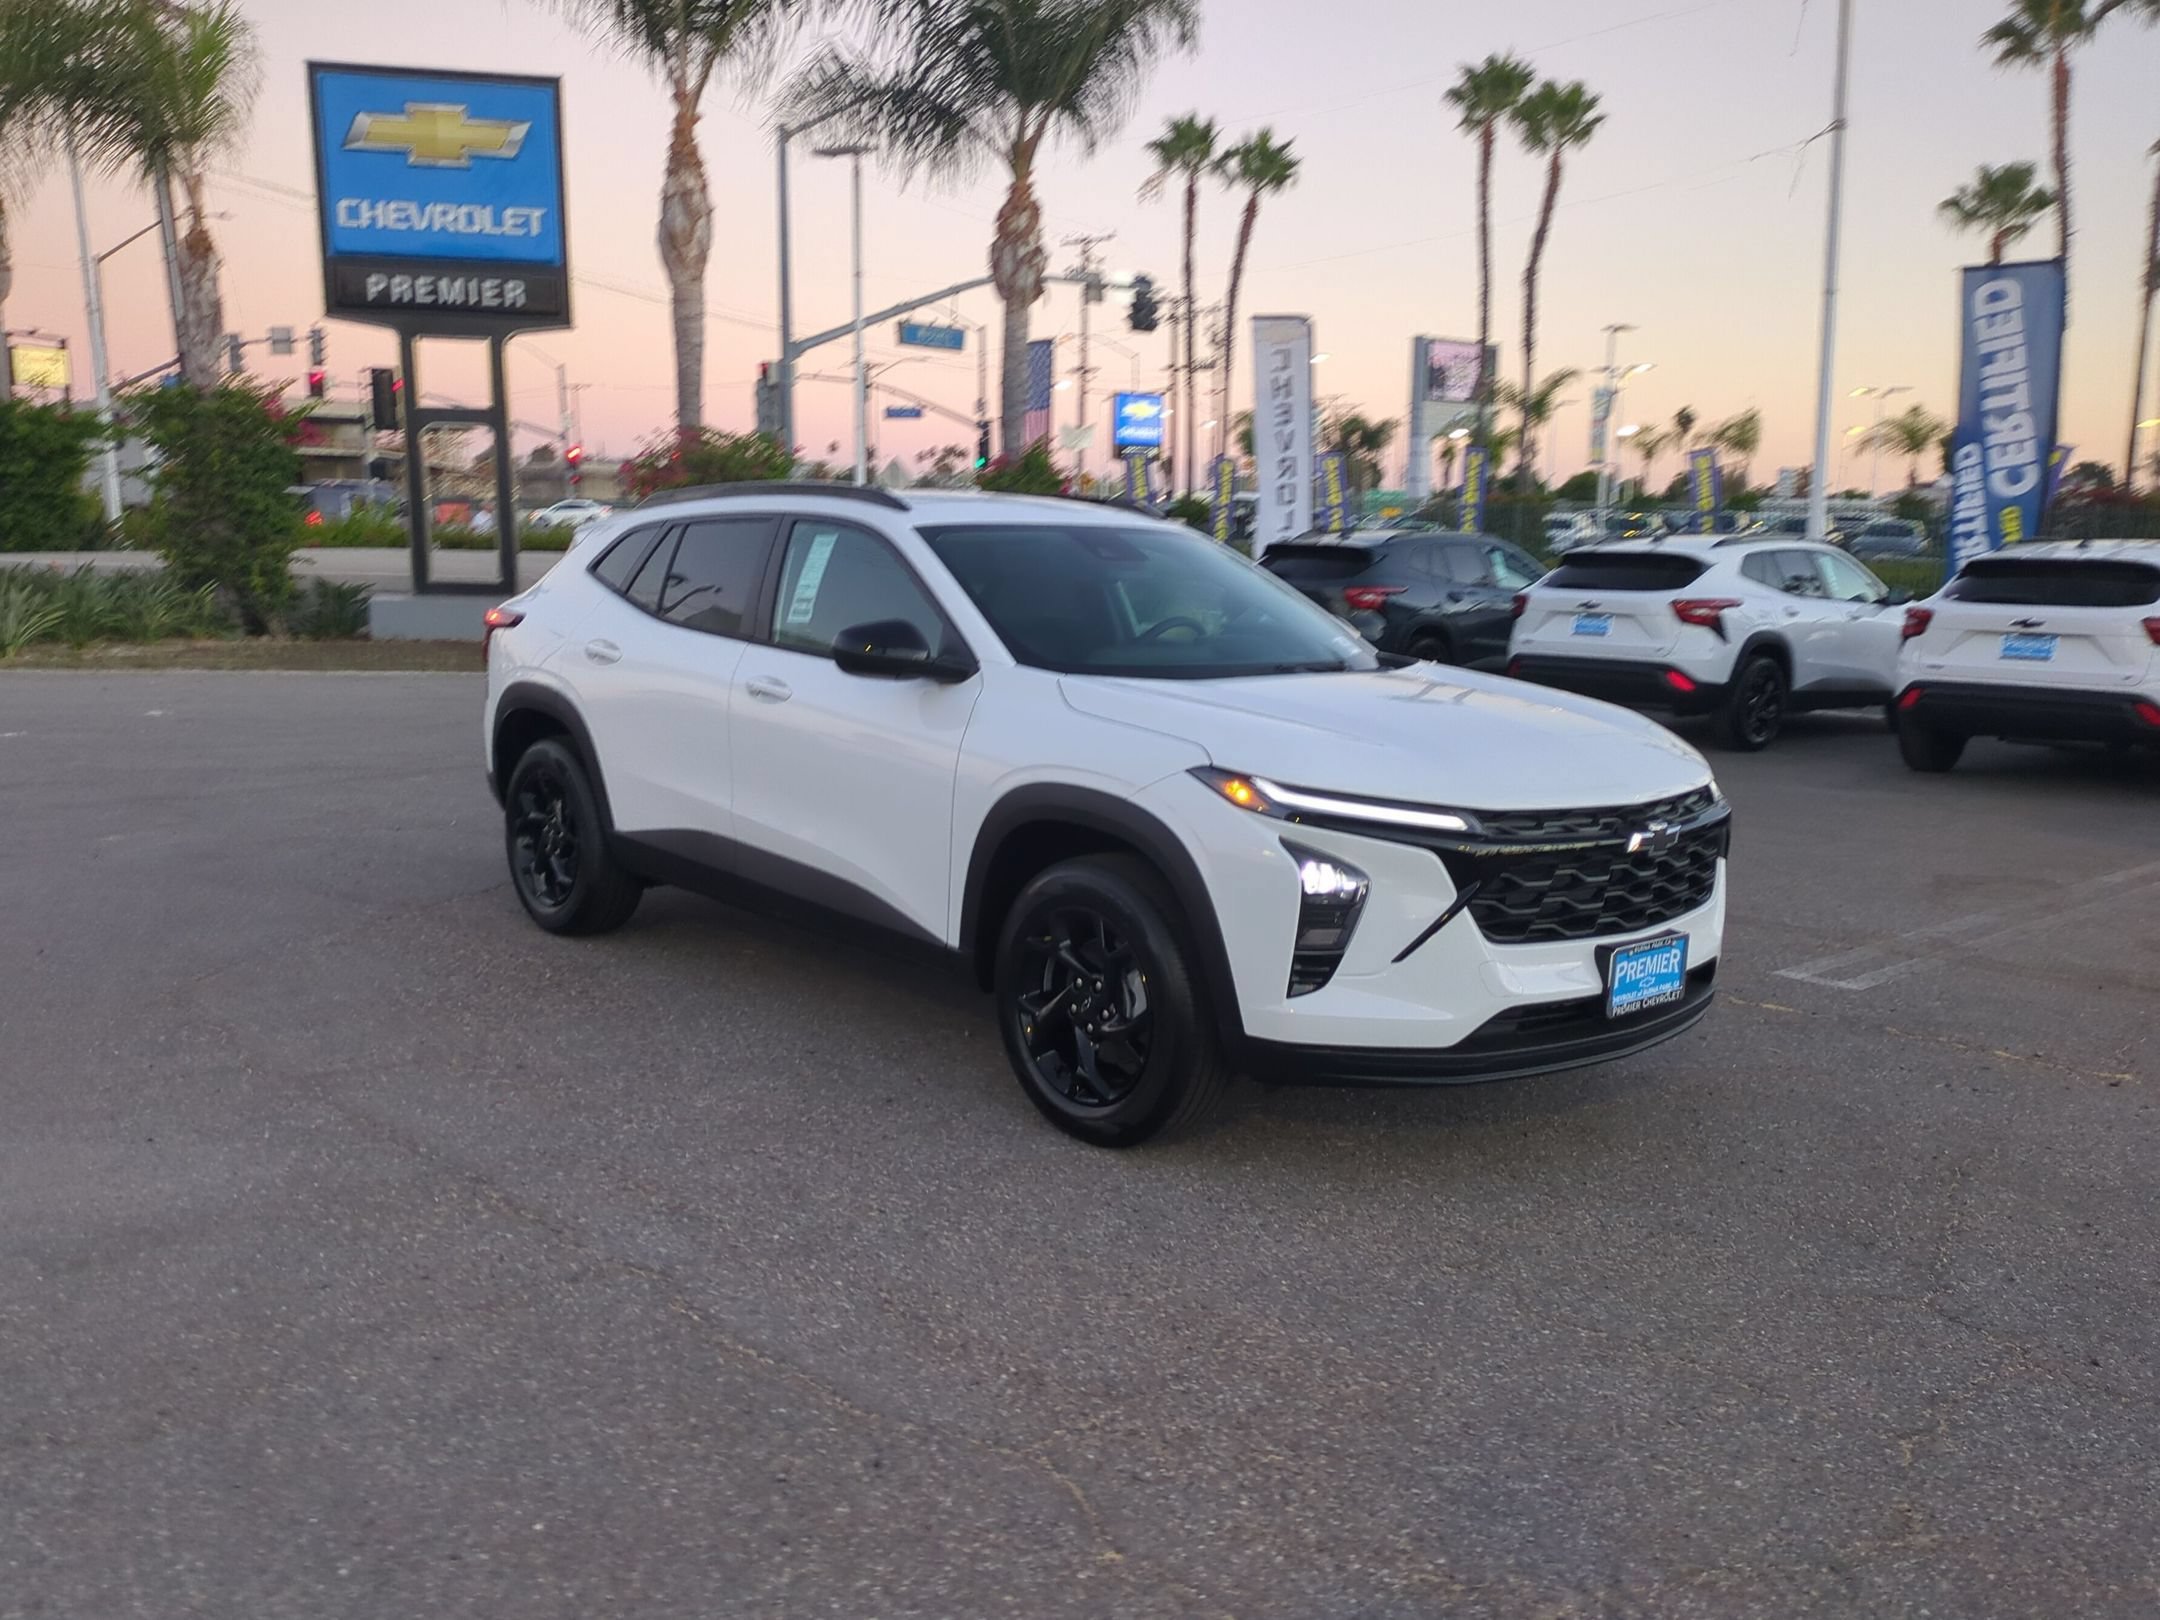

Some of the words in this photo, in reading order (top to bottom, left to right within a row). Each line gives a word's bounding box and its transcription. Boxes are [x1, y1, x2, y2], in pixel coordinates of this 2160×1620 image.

[336, 198, 547, 237] CHEVROLET
[366, 272, 527, 308] PREMIER
[1973, 279, 2040, 498] CERTIFIED
[1614, 948, 1681, 990] PREMIER
[1612, 1000, 1640, 1017] PREMIER
[1643, 990, 1680, 1008] CHEVROLET
